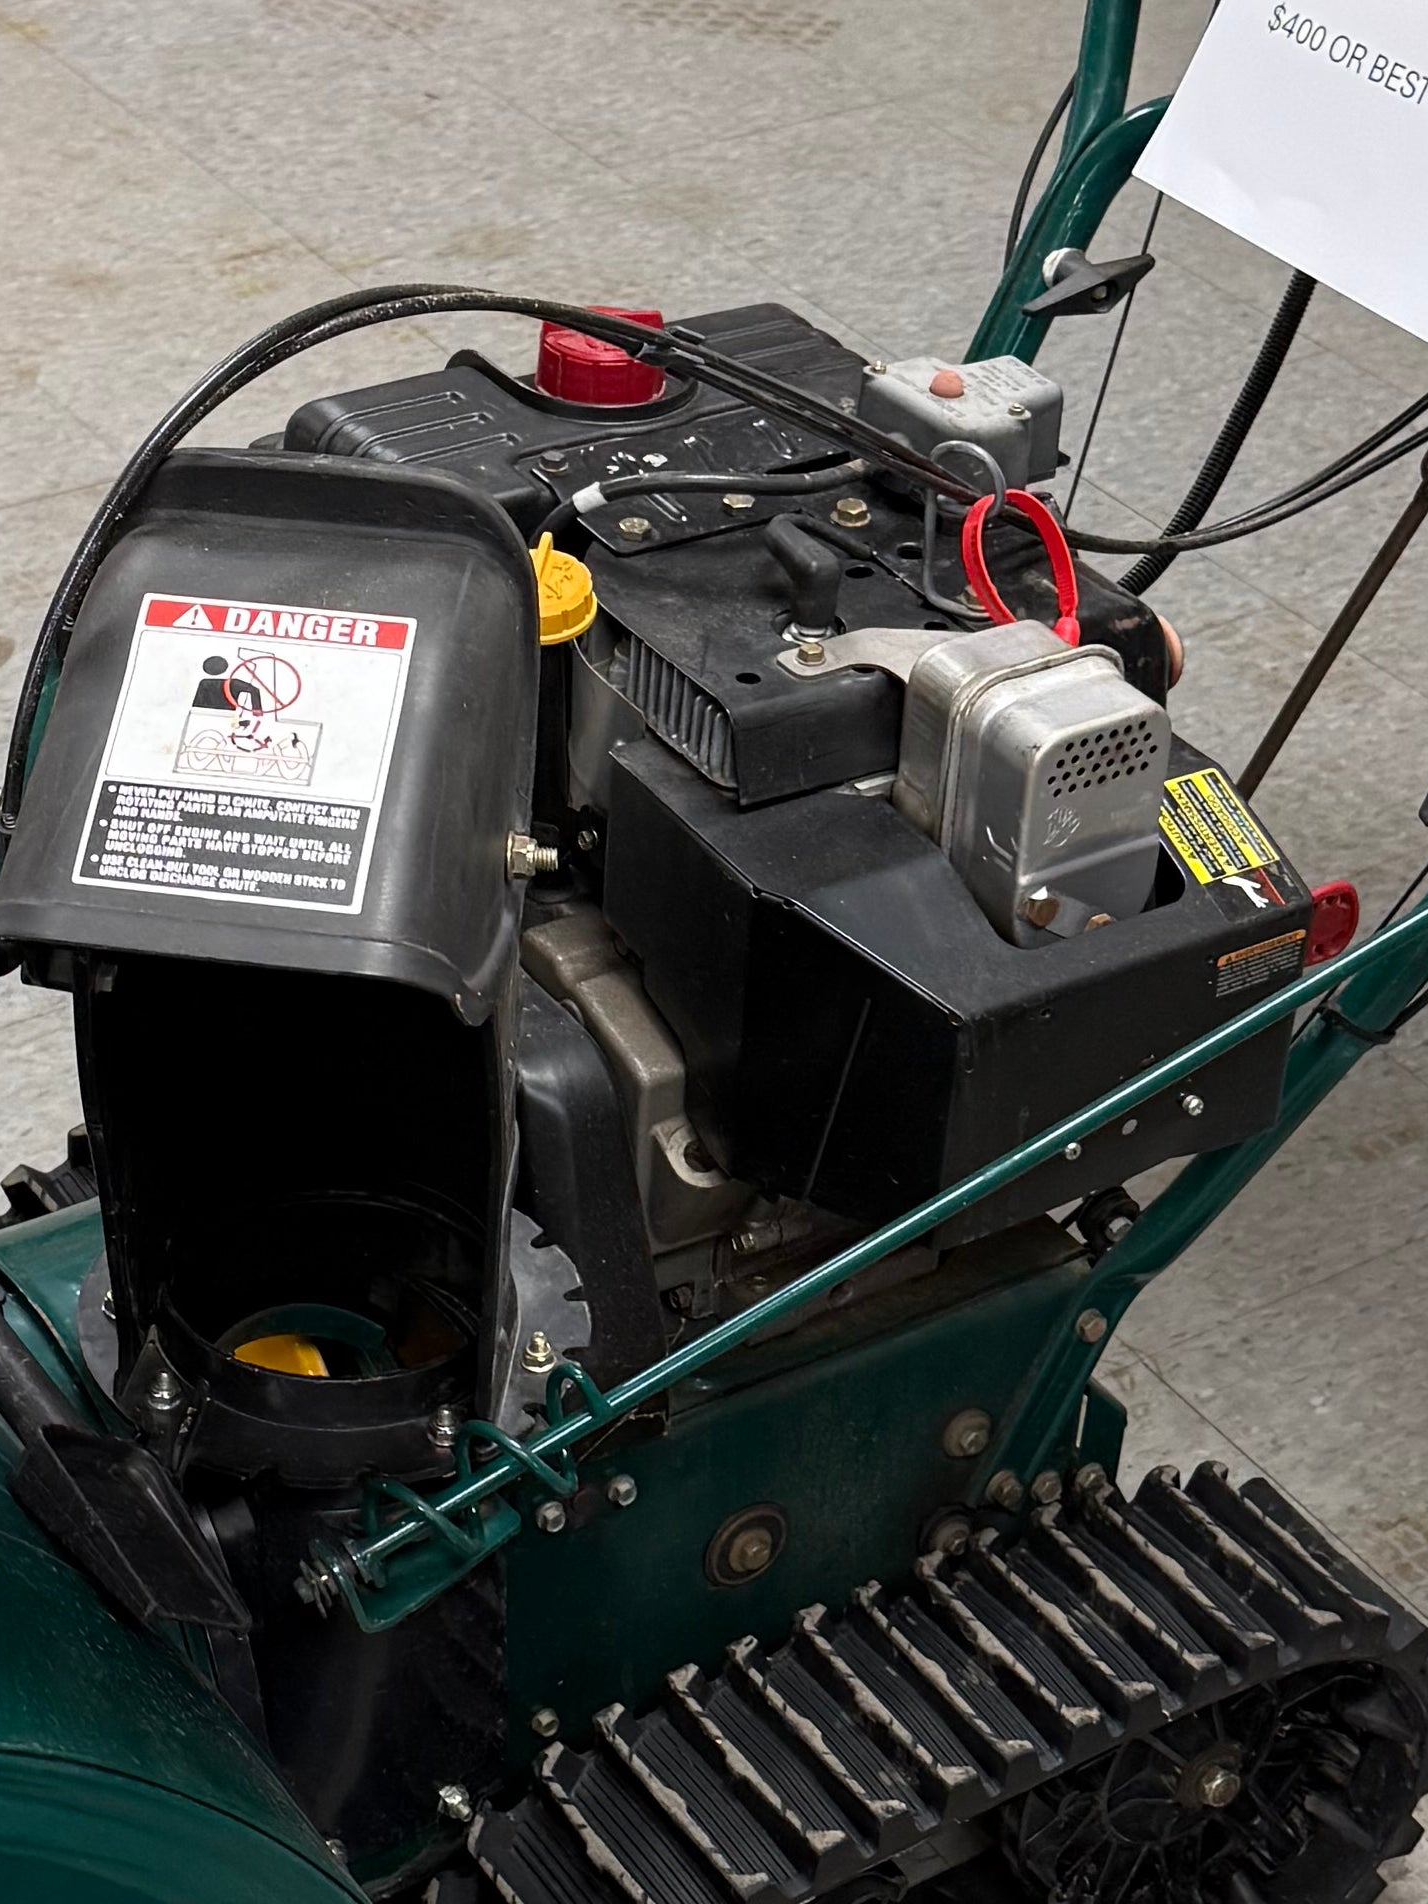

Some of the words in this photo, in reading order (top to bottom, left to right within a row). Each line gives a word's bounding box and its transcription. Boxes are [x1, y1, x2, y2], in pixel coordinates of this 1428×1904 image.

[1267, 1, 1327, 52] $400
[1328, 35, 1368, 74] OR
[223, 607, 379, 646] DANGER
[113, 805, 139, 817] AND
[116, 795, 175, 810] ROTATING
[177, 801, 215, 815] PARTS
[217, 805, 242, 817] CAN
[243, 808, 305, 824] AMPUTATE
[307, 815, 358, 830] FINGERS
[119, 785, 157, 798] NEVER
[158, 788, 182, 801] PUT
[183, 791, 216, 804] HAND
[218, 794, 231, 805] IN
[276, 801, 328, 815] CONTACT
[330, 806, 361, 820] WITH
[107, 829, 158, 844] MOVING
[161, 834, 202, 849] PARTS
[205, 839, 239, 854] HAVE
[242, 843, 299, 859] STOPPED
[301, 849, 351, 865] BEFORE
[110, 818, 145, 832] SHUT
[147, 822, 172, 835] OFF
[174, 826, 221, 840] ENGINE
[223, 830, 250, 843] AND
[254, 833, 286, 846] WAIT
[289, 837, 325, 852] UNTIL
[329, 842, 352, 855] ALL
[99, 864, 148, 880] UNCLOG
[149, 871, 217, 887] DISCHARGE
[101, 853, 125, 866] USE
[126, 856, 190, 873] CLEAN-OUT
[192, 863, 220, 877] TOOL
[222, 866, 240, 879] OR
[242, 869, 292, 885] WOODEN
[294, 874, 329, 889] STICK
[330, 878, 346, 891] TO
